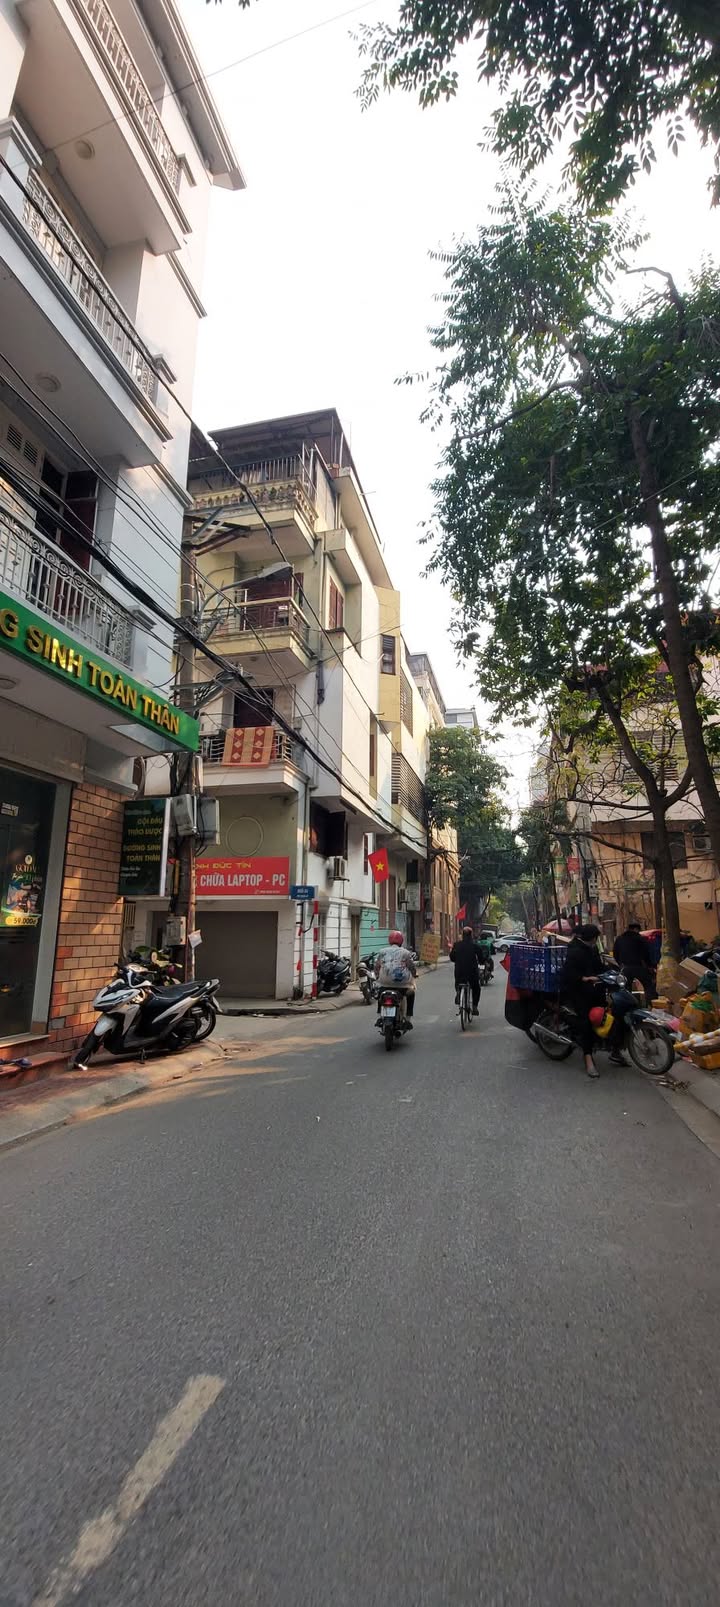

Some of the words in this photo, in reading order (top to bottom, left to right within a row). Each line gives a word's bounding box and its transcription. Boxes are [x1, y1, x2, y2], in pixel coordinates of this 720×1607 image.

[26, 625, 83, 678] SINH
[87, 661, 137, 710] TOÀN
[141, 694, 180, 735] THÂN
[200, 872, 225, 887] CHỮA
[227, 873, 263, 887] LAPTOP
[272, 873, 286, 887] PC
